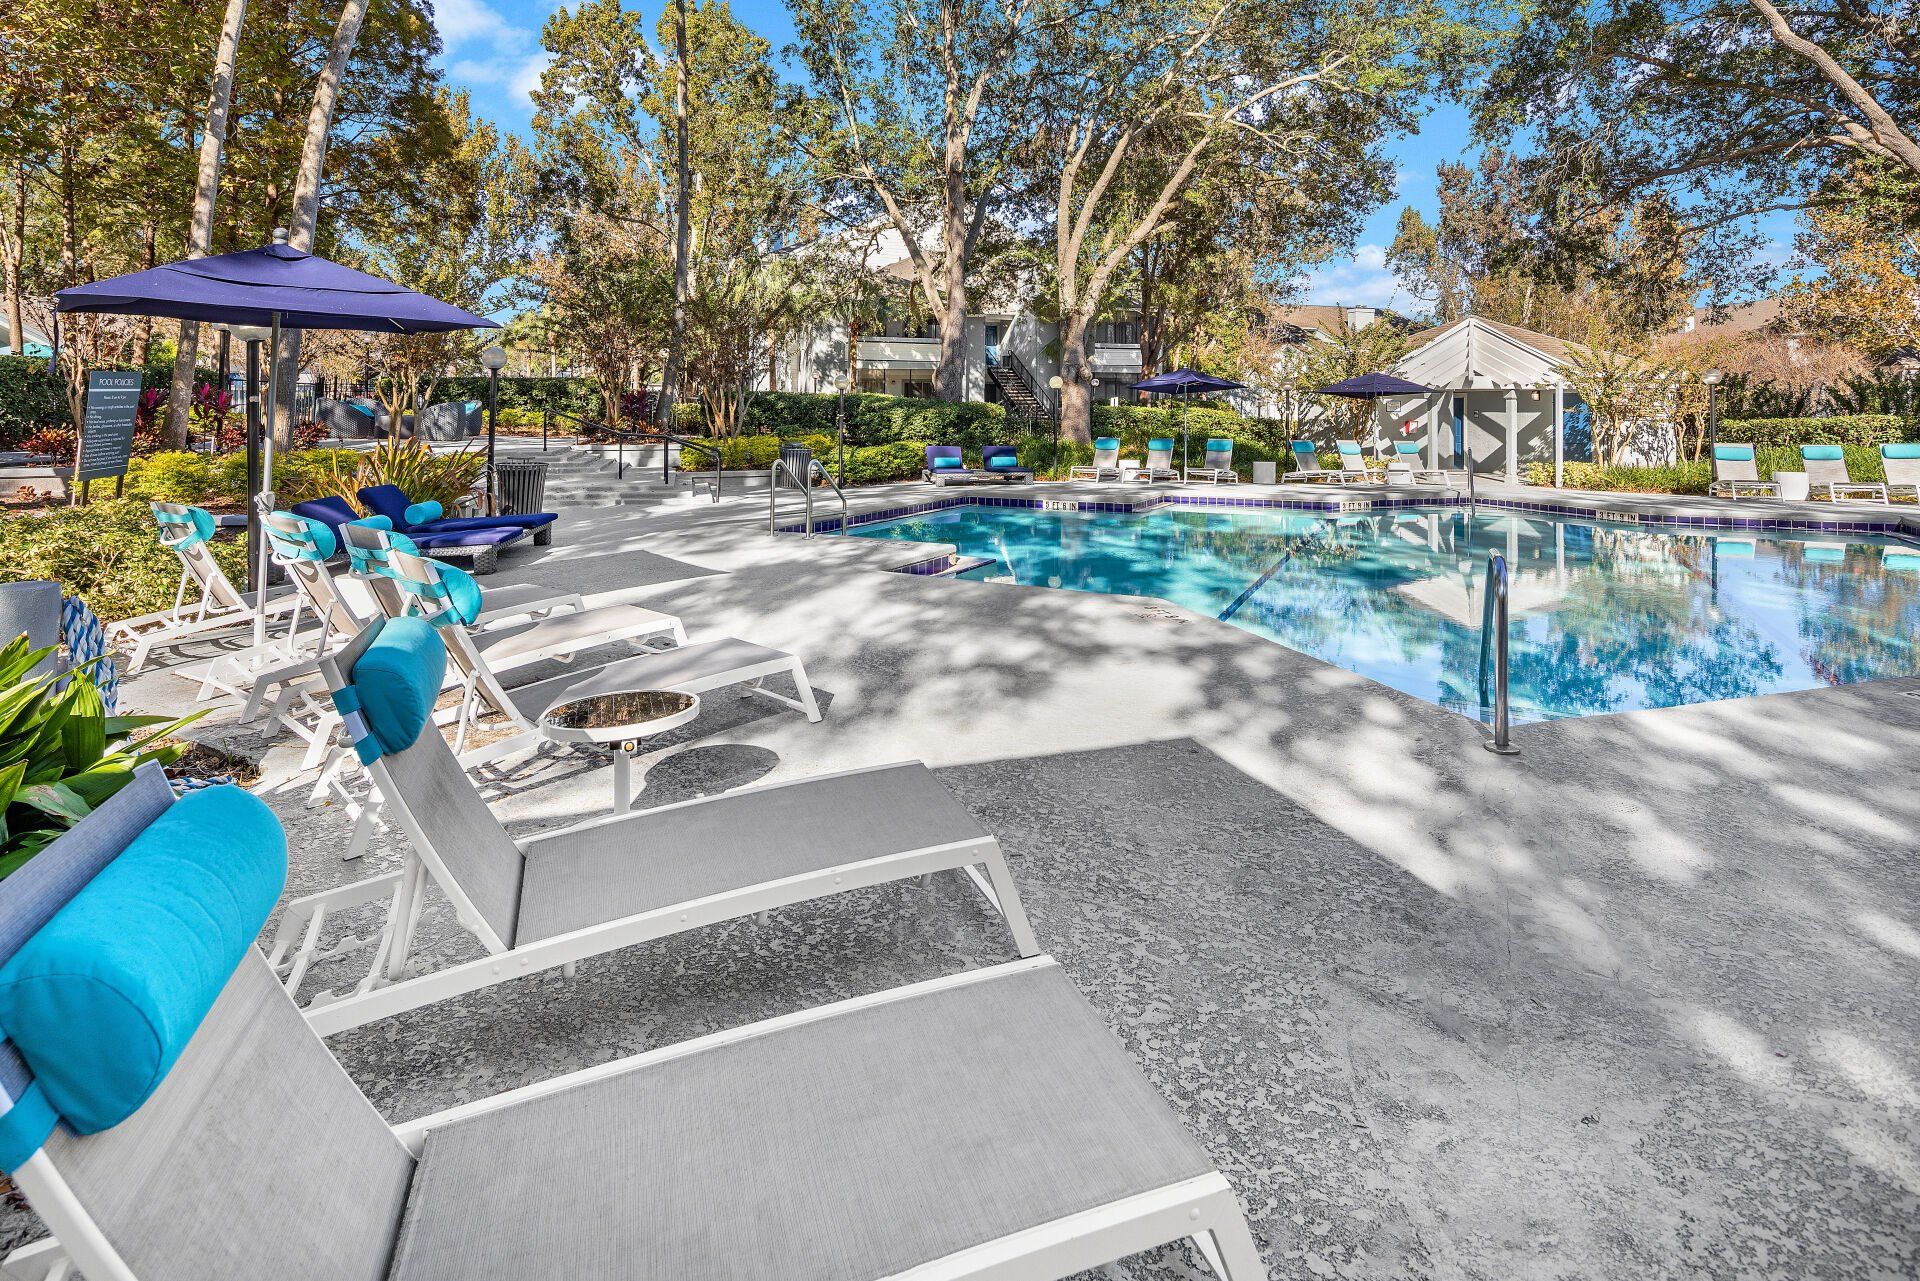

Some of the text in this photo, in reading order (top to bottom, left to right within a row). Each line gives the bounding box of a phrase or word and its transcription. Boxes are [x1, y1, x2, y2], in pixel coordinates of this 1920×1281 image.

[98, 378, 134, 386] POOL POLICIES
[1069, 502, 1077, 511] IN
[1363, 501, 1370, 509] IN
[1606, 511, 1616, 520] FT
[1627, 513, 1636, 521] IN
